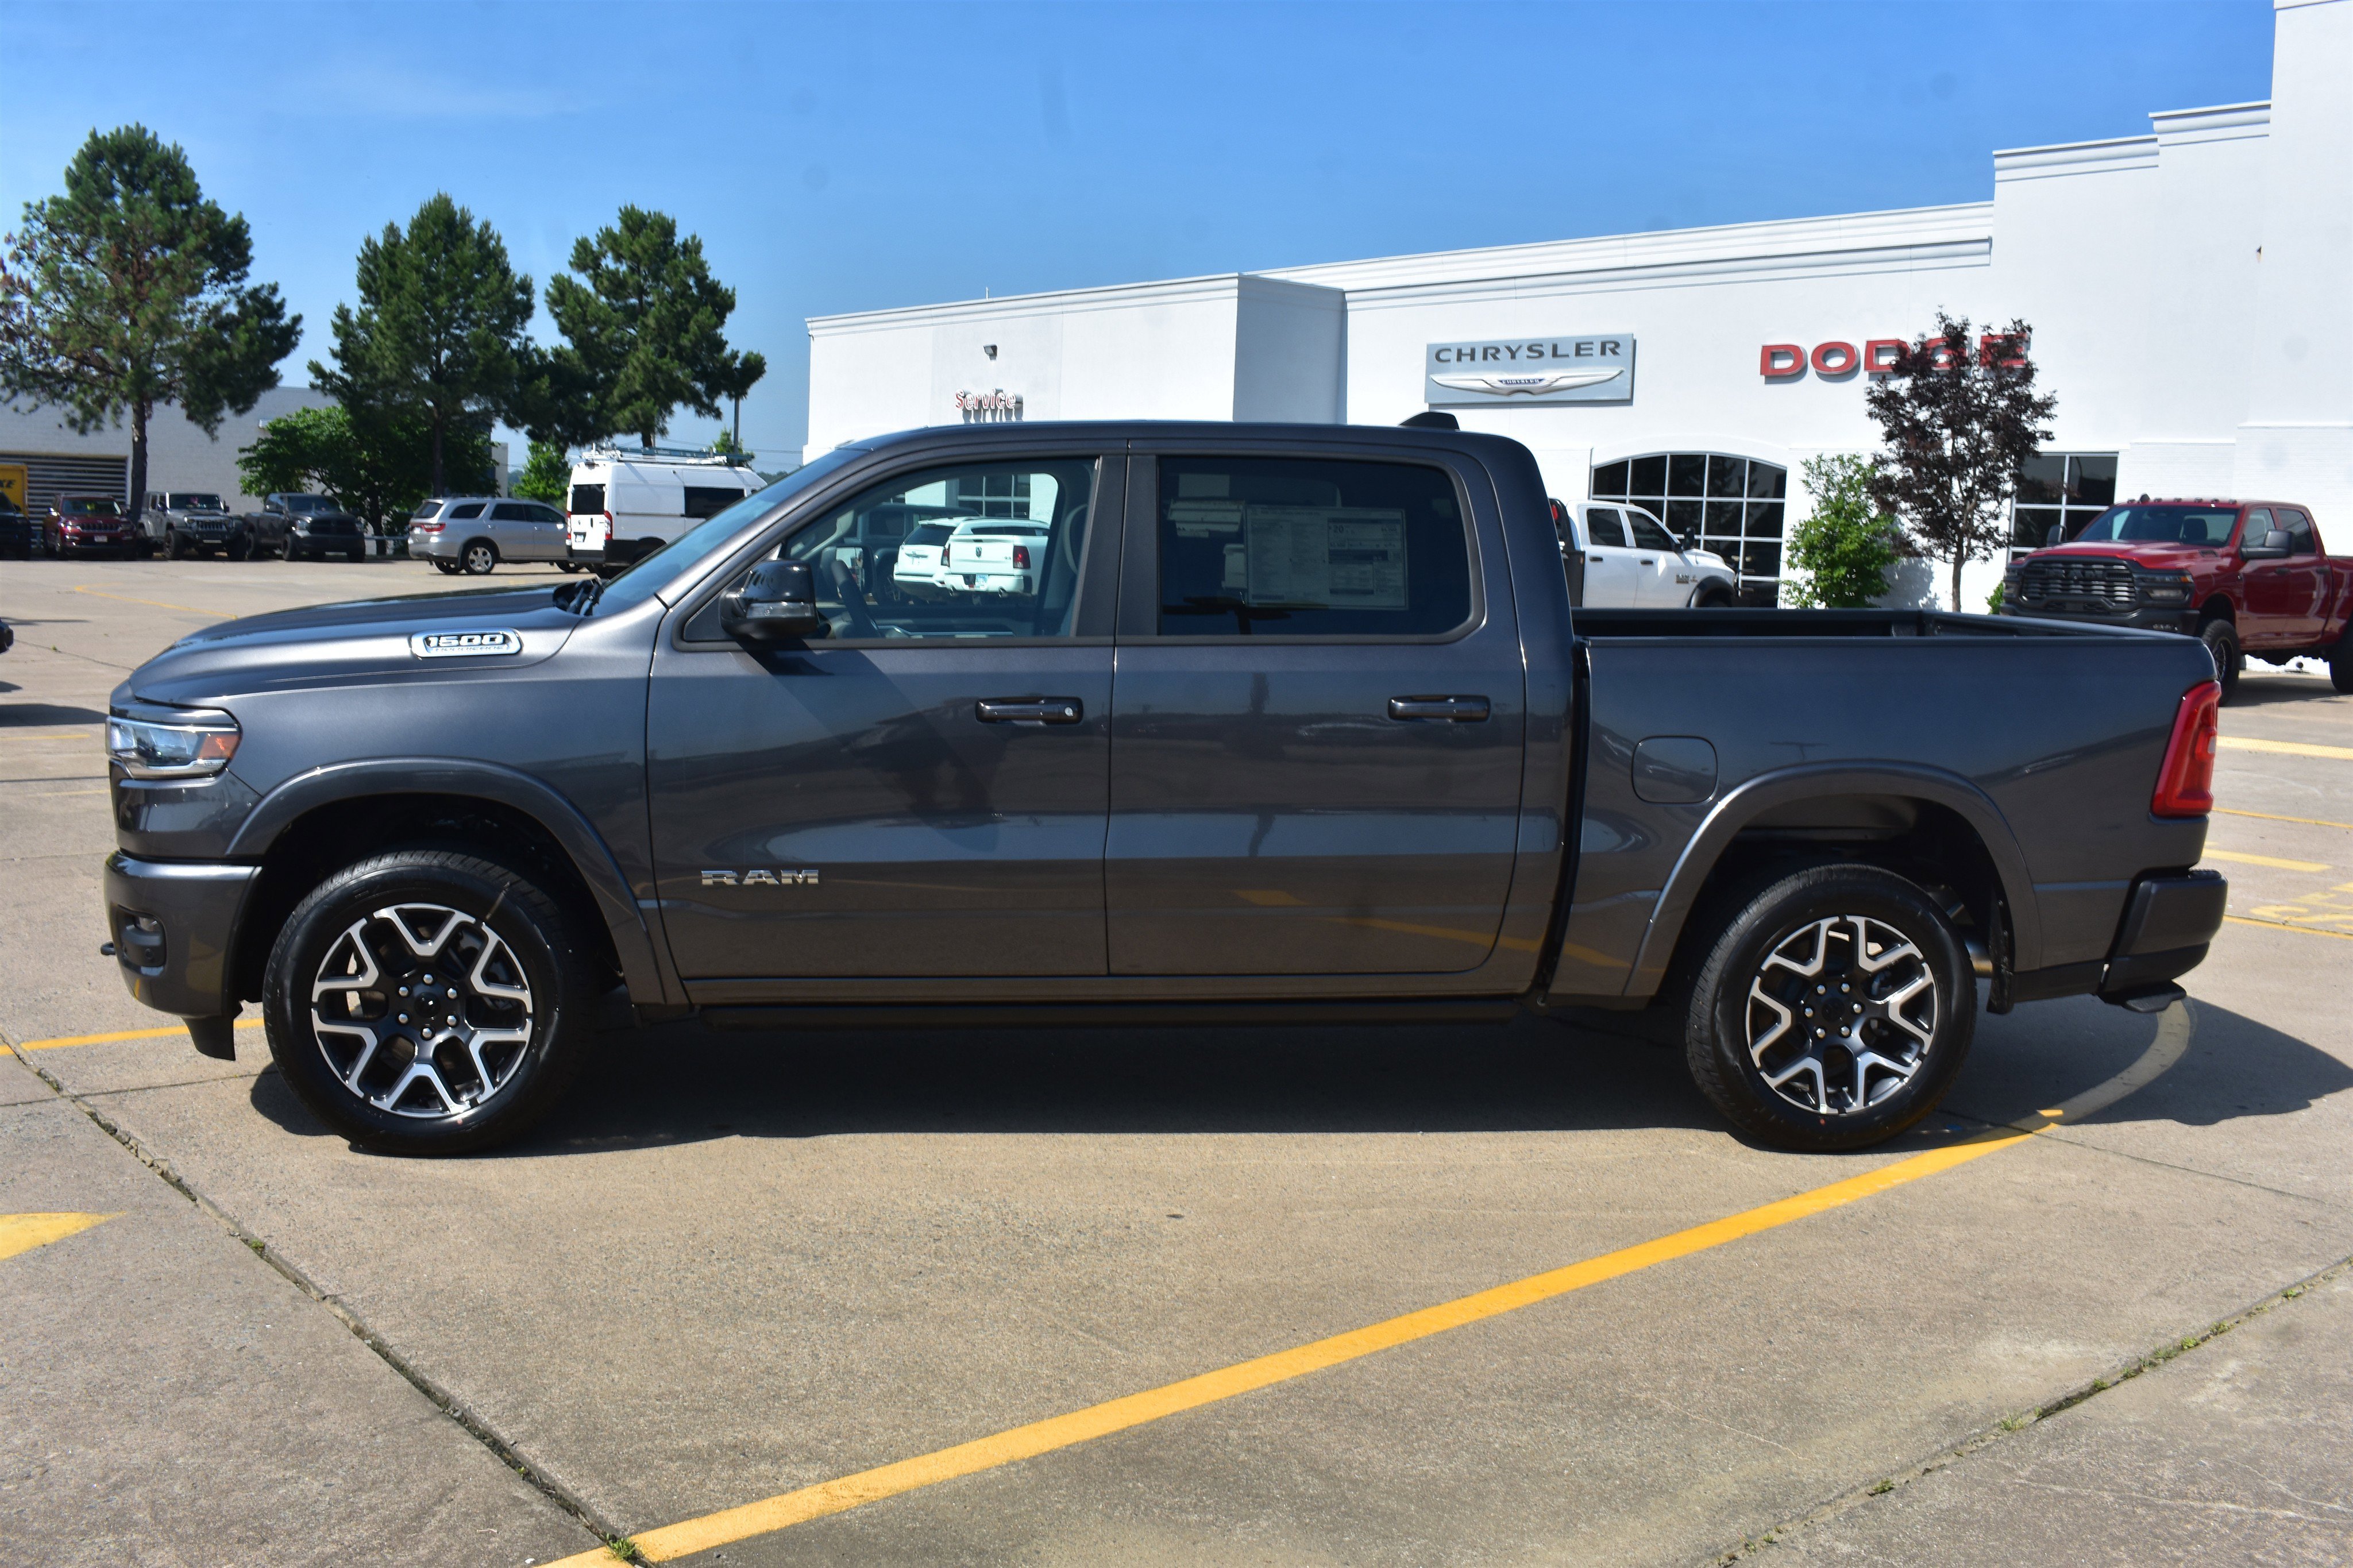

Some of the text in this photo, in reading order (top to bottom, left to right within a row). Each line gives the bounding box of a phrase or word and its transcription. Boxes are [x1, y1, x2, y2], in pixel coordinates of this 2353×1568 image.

[1434, 339, 1621, 362] CHRYSLER
[1760, 333, 2027, 376] DODGE
[955, 388, 1016, 410] Service
[428, 634, 504, 647] 1500
[701, 869, 819, 886] RAM
